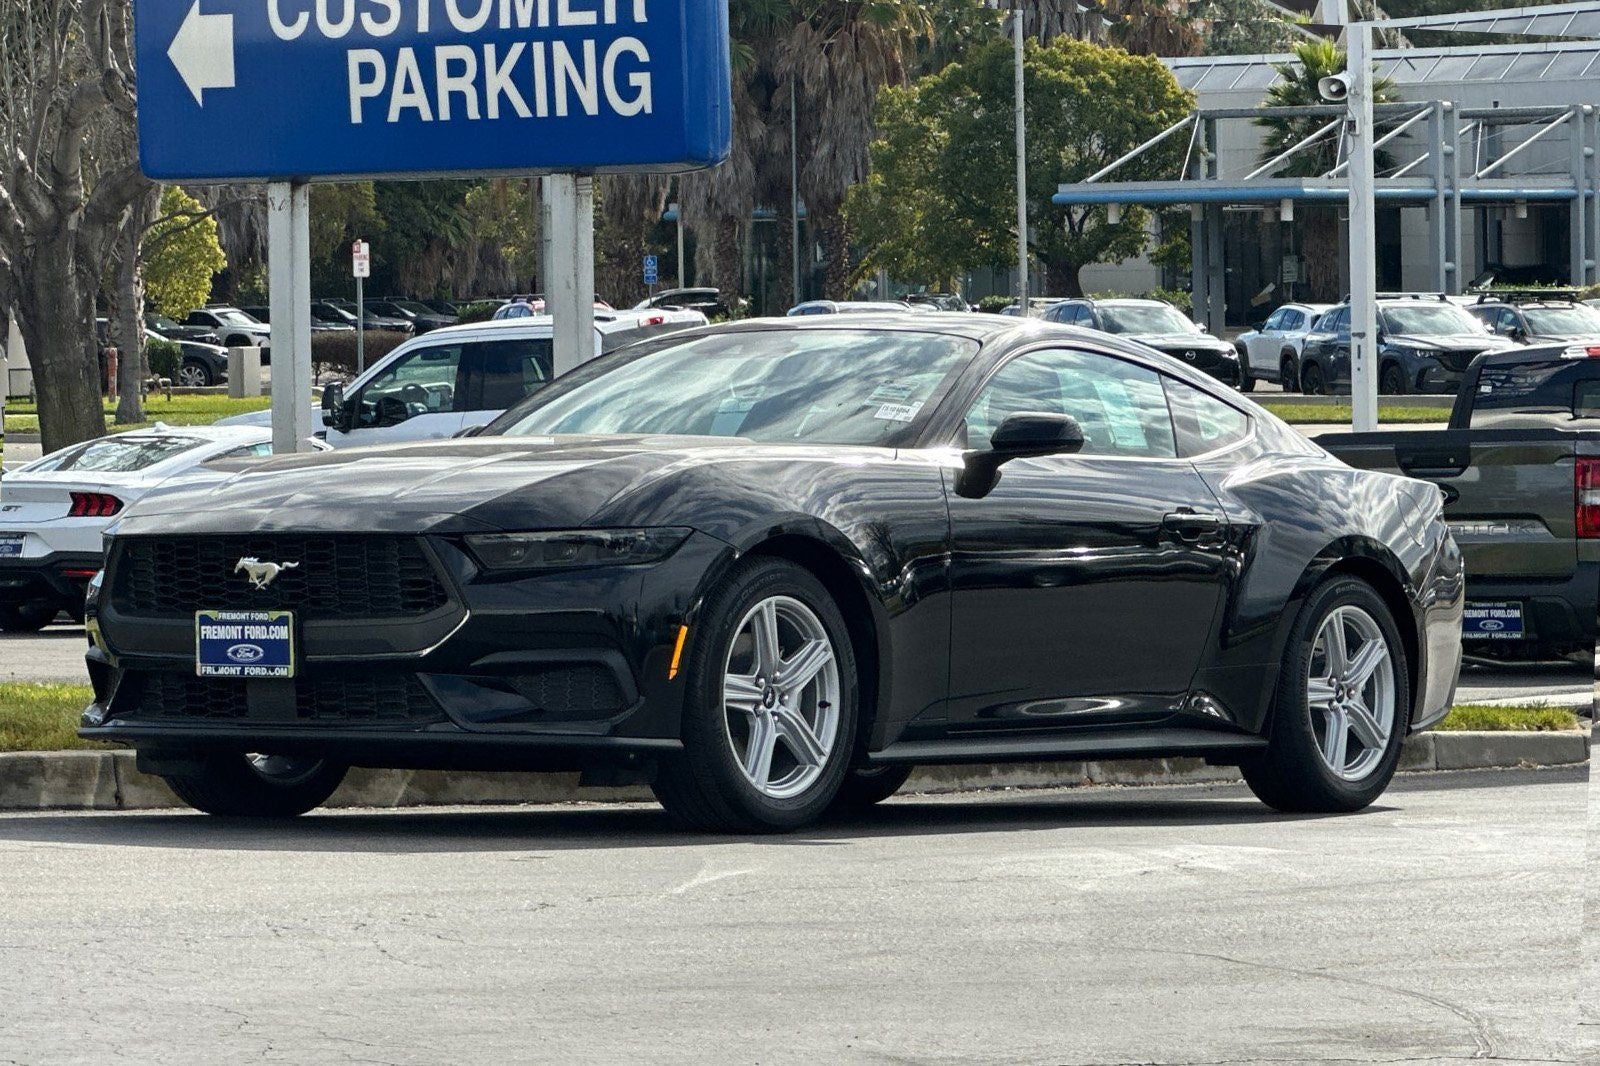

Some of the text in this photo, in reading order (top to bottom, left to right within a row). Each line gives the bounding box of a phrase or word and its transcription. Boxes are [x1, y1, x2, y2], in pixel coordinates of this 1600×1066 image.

[347, 36, 653, 124] PARKING
[218, 612, 268, 620] FREMONT FORD
[1463, 609, 1521, 618] REMONT FORD.COM
[201, 625, 288, 640] FREMONT FORD.COM
